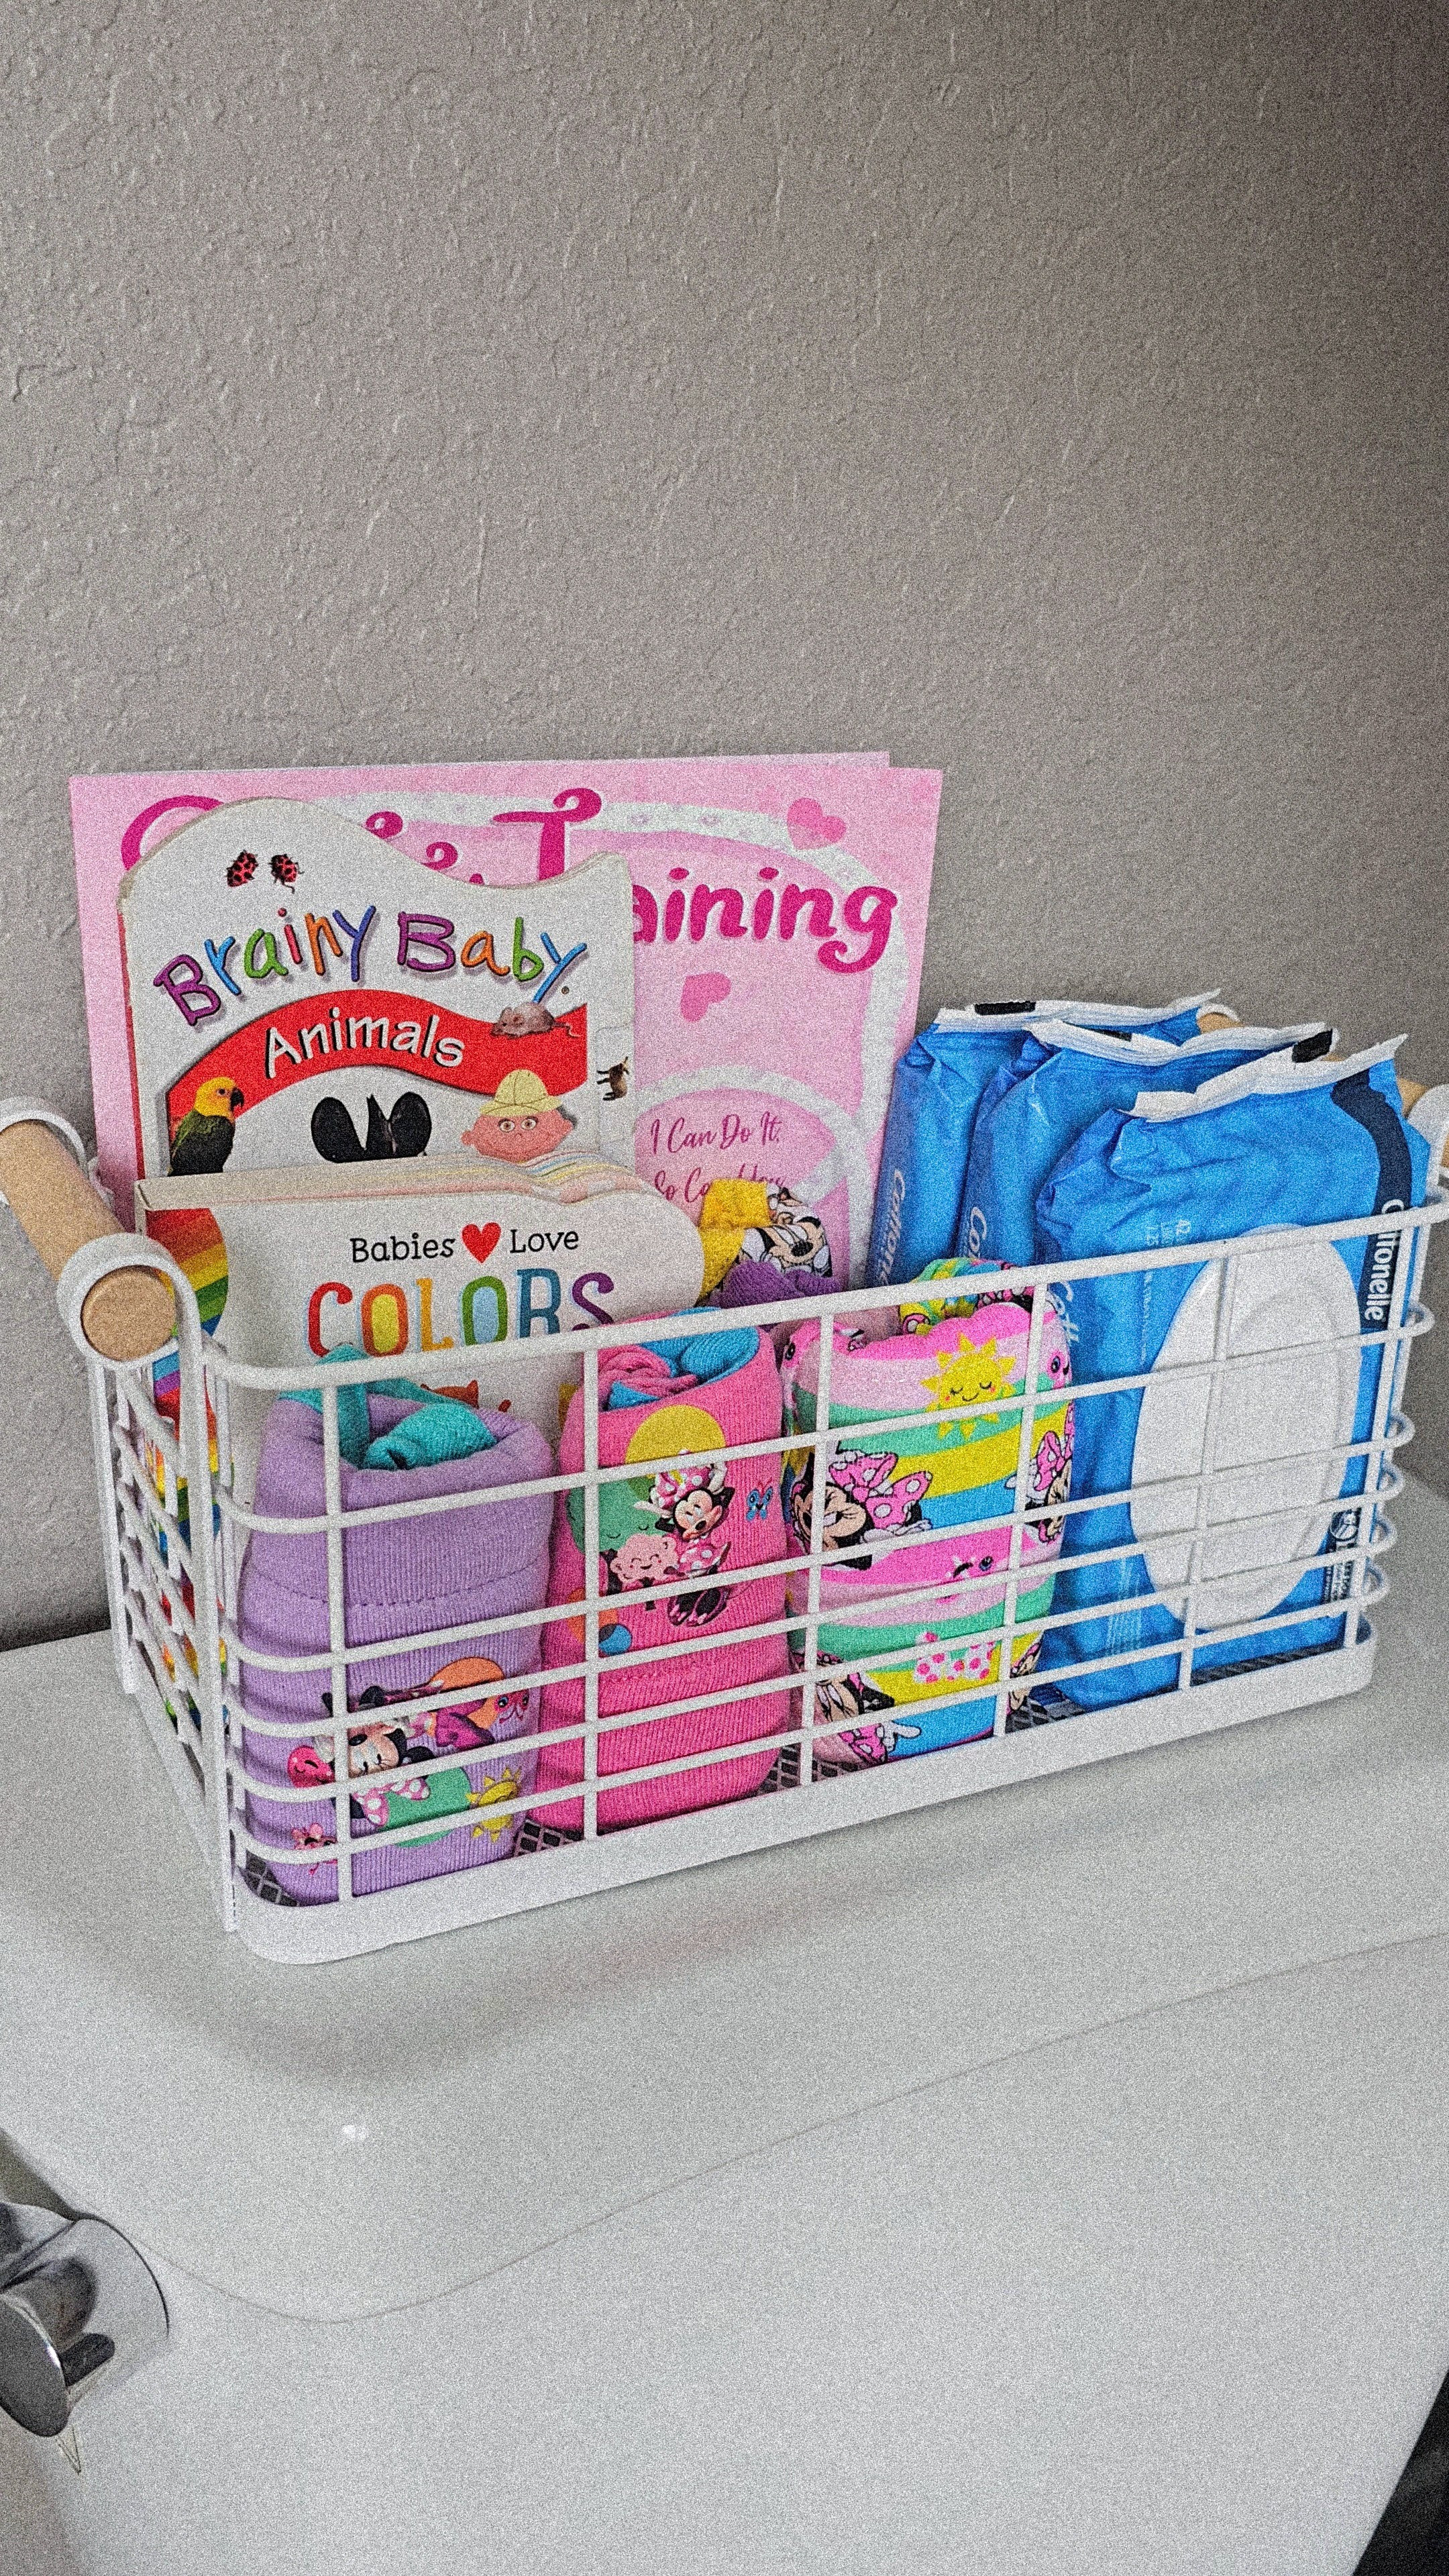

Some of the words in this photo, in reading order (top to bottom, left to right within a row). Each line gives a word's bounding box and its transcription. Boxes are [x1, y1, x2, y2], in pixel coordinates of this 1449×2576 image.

[397, 912, 588, 1006] Baby
[266, 1007, 465, 1079] Animals
[651, 1119, 661, 1155] I
[667, 1117, 717, 1154] Can
[720, 1114, 752, 1150] Do
[350, 1233, 455, 1263] Babies
[510, 1229, 580, 1254] Love
[1364, 1198, 1405, 1322] Cttonelle
[307, 1268, 615, 1358] COLORS
